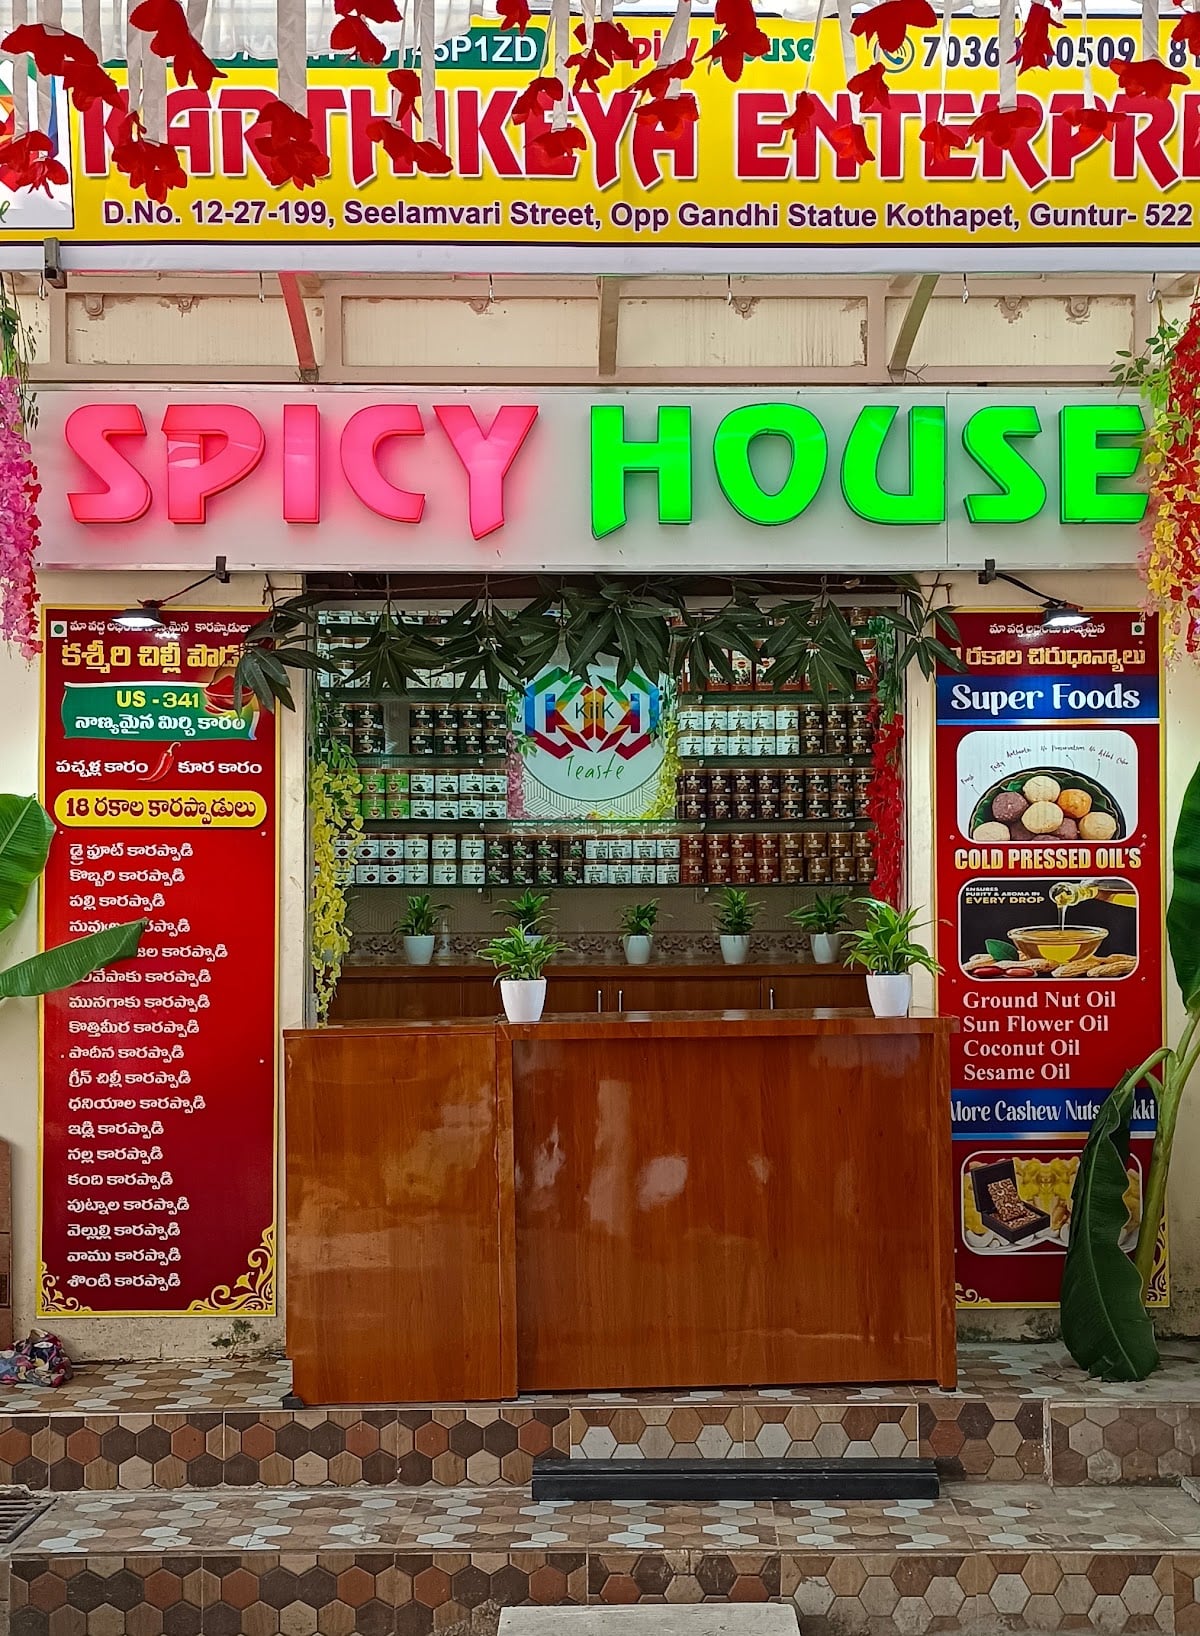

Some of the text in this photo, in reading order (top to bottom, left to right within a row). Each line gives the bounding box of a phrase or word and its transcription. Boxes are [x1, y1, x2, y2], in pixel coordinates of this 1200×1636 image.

[104, 201, 1193, 232] D.No. 12-27-199, Seelamvari Street, Opp Gandhi Statue Kothapet, Guntur- 522
[64, 402, 1149, 541] SPICY HOUSE
[116, 690, 147, 709] US
[162, 691, 200, 709] 341
[950, 682, 1142, 716] Super Foods
[103, 760, 150, 775] కారం
[217, 760, 264, 775] కారం
[65, 796, 91, 819] 18
[94, 796, 145, 819] రకాల
[954, 847, 1143, 871] COLD PRESSED OIL'S
[965, 896, 1046, 905] EVERY DROP
[962, 991, 1117, 1009] Ground Nut Oil
[963, 1015, 1110, 1033] Sun Flower Oil
[963, 1039, 1081, 1057] Coconut Oil
[963, 1063, 1072, 1081] Sesame Oil
[950, 1100, 992, 1122] More
[994, 1099, 1062, 1122] Cashew
[1065, 1099, 1101, 1120] Nuts
